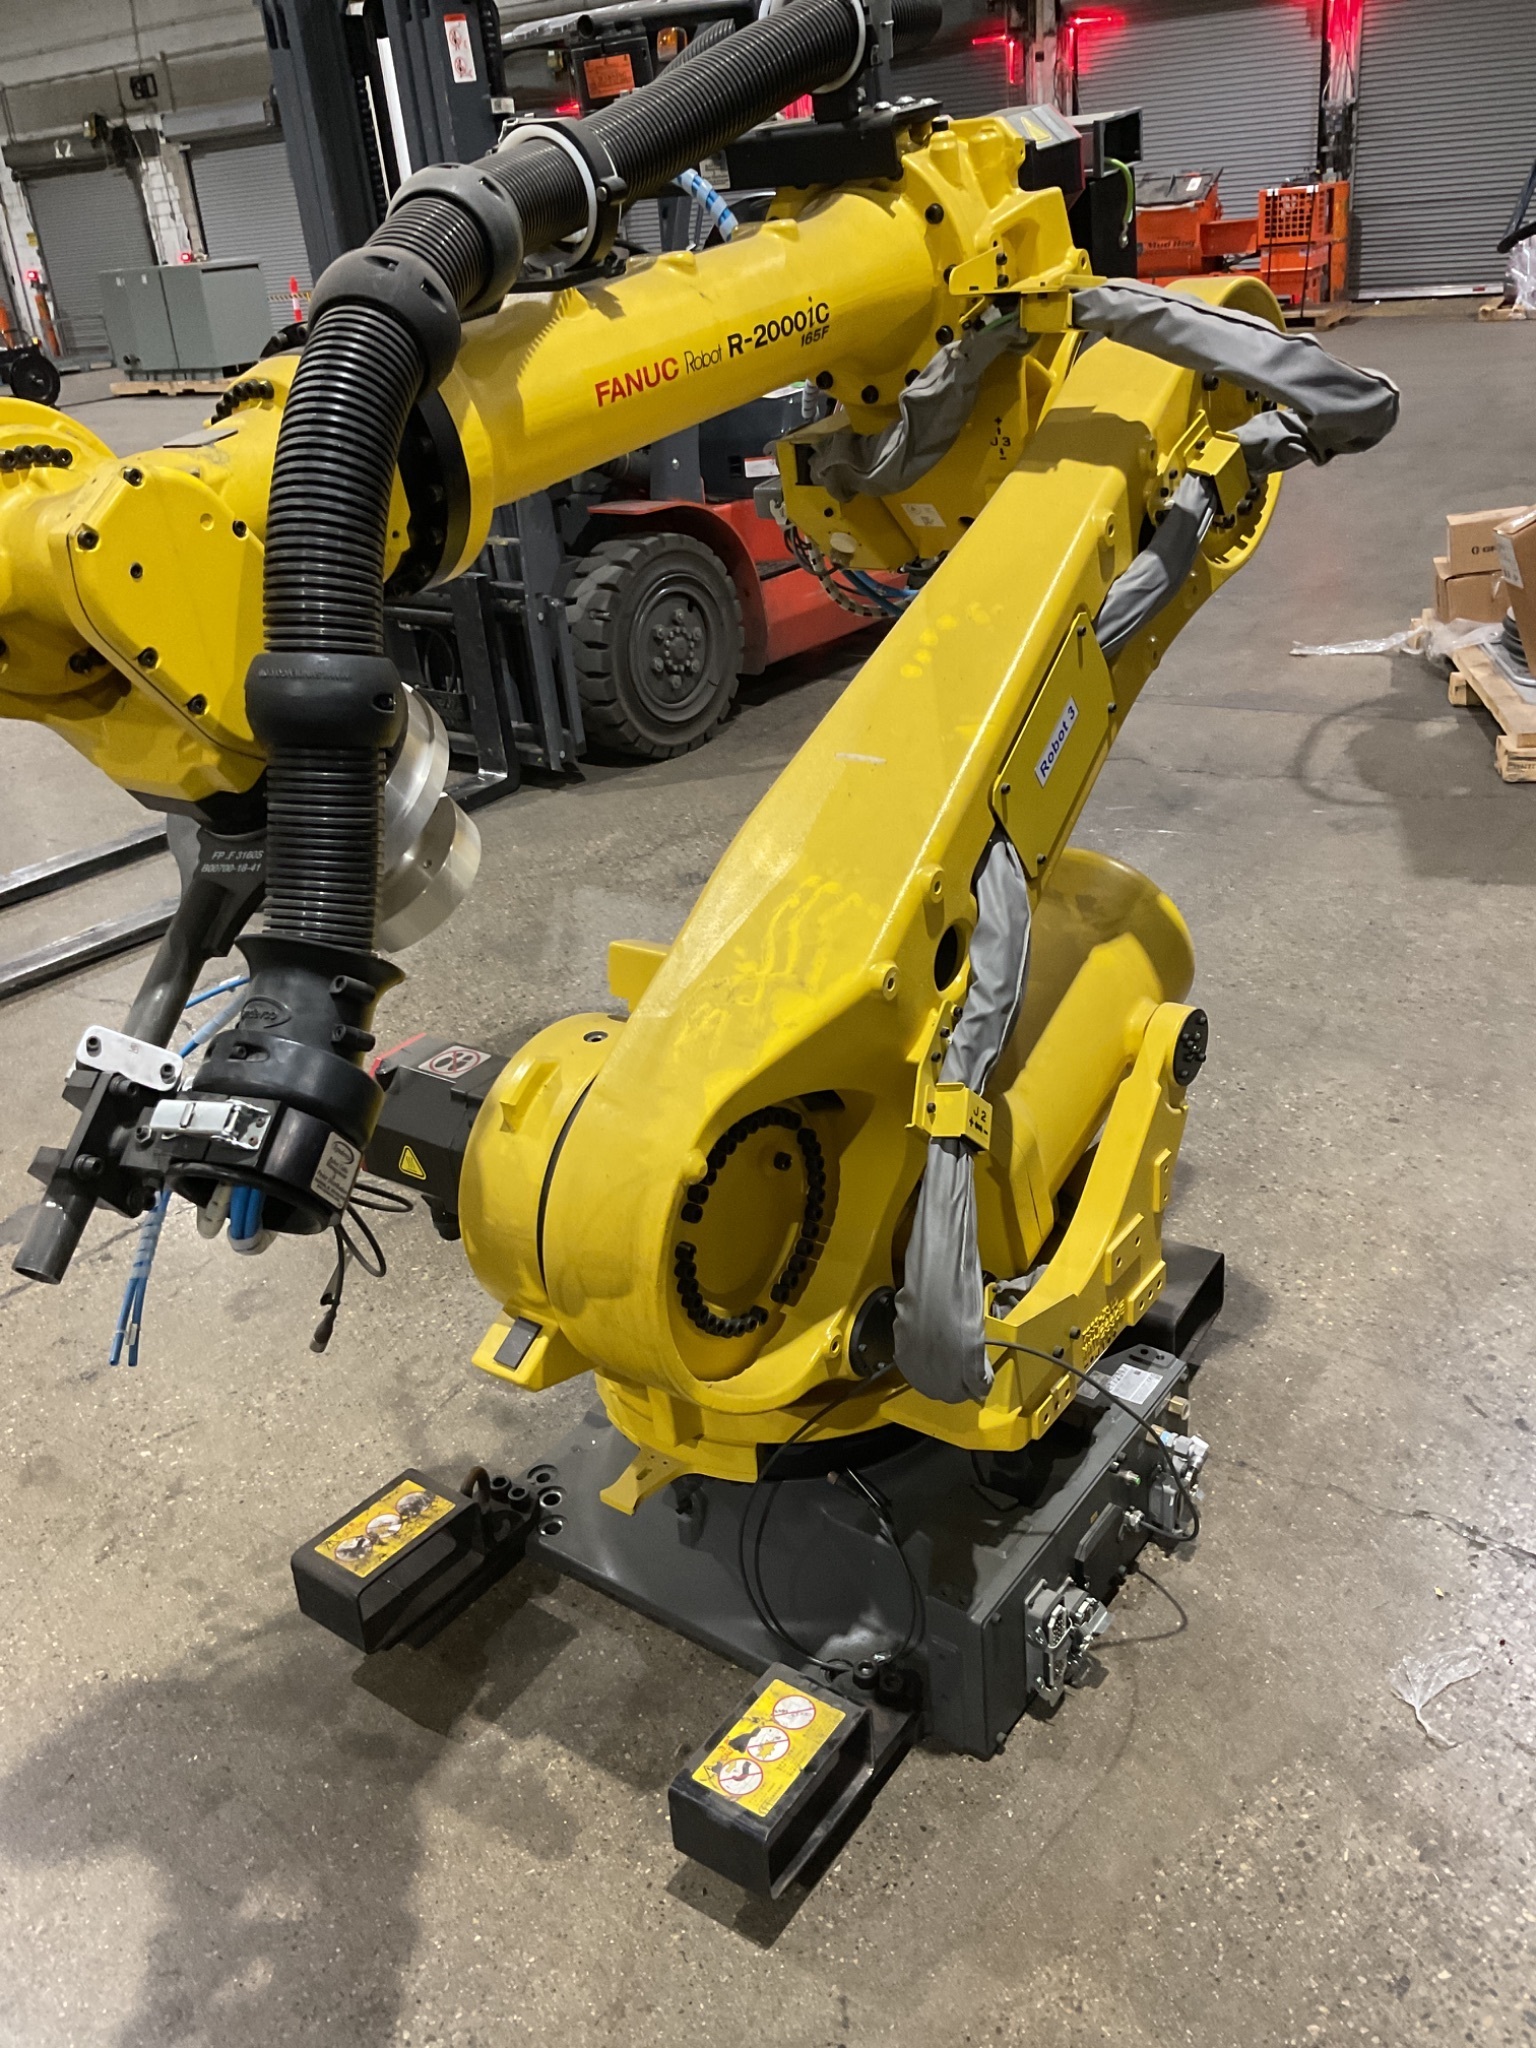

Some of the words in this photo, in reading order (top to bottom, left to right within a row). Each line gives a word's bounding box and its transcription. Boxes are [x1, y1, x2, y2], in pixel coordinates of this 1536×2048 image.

[594, 357, 680, 408] FANUC
[683, 344, 722, 375] Robot
[726, 296, 830, 358] R-2000iC
[801, 325, 830, 347] 165F
[1040, 720, 1069, 778] Robot
[1067, 705, 1076, 720] 3
